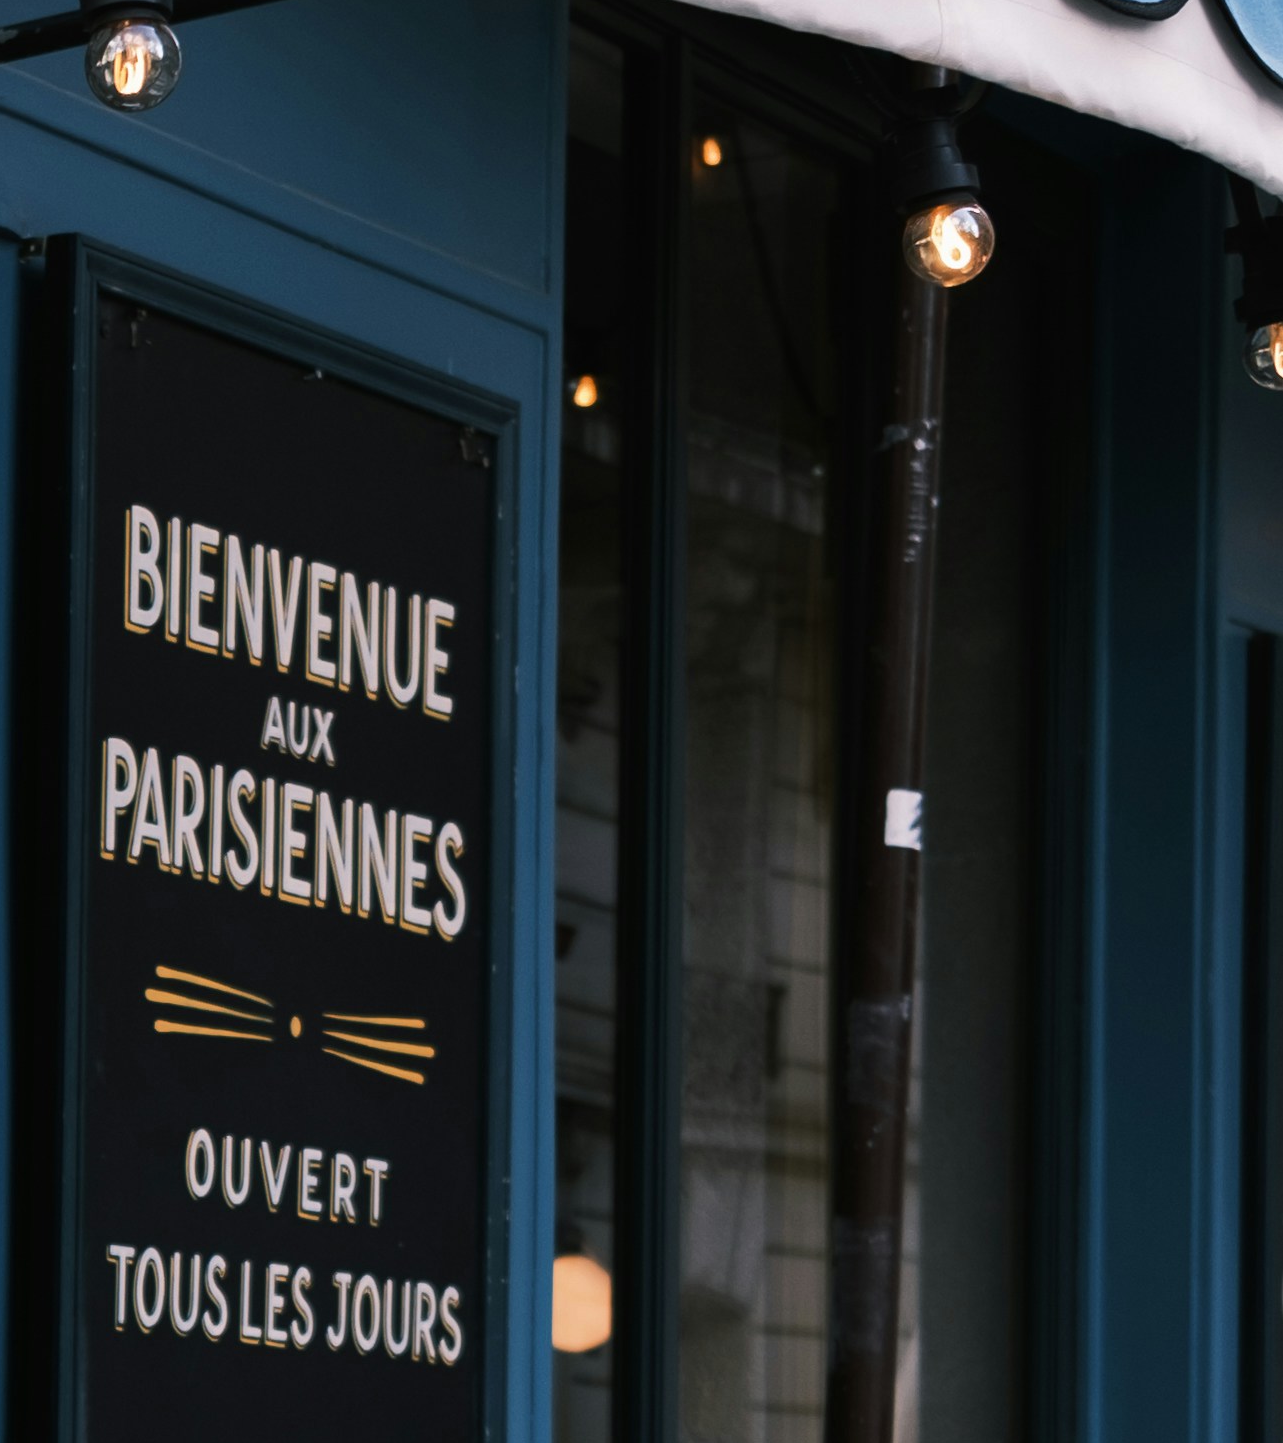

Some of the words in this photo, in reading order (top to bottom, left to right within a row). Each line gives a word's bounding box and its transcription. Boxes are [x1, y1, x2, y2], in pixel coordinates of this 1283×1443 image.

[124, 504, 456, 722] BIENVENUE
[261, 696, 336, 767] AUX
[101, 736, 467, 942] PARISIENNES
[184, 1128, 389, 1226] OUVERT
[106, 1244, 228, 1342] TOUS
[239, 1259, 315, 1349] LES
[326, 1270, 463, 1365] JOURS
